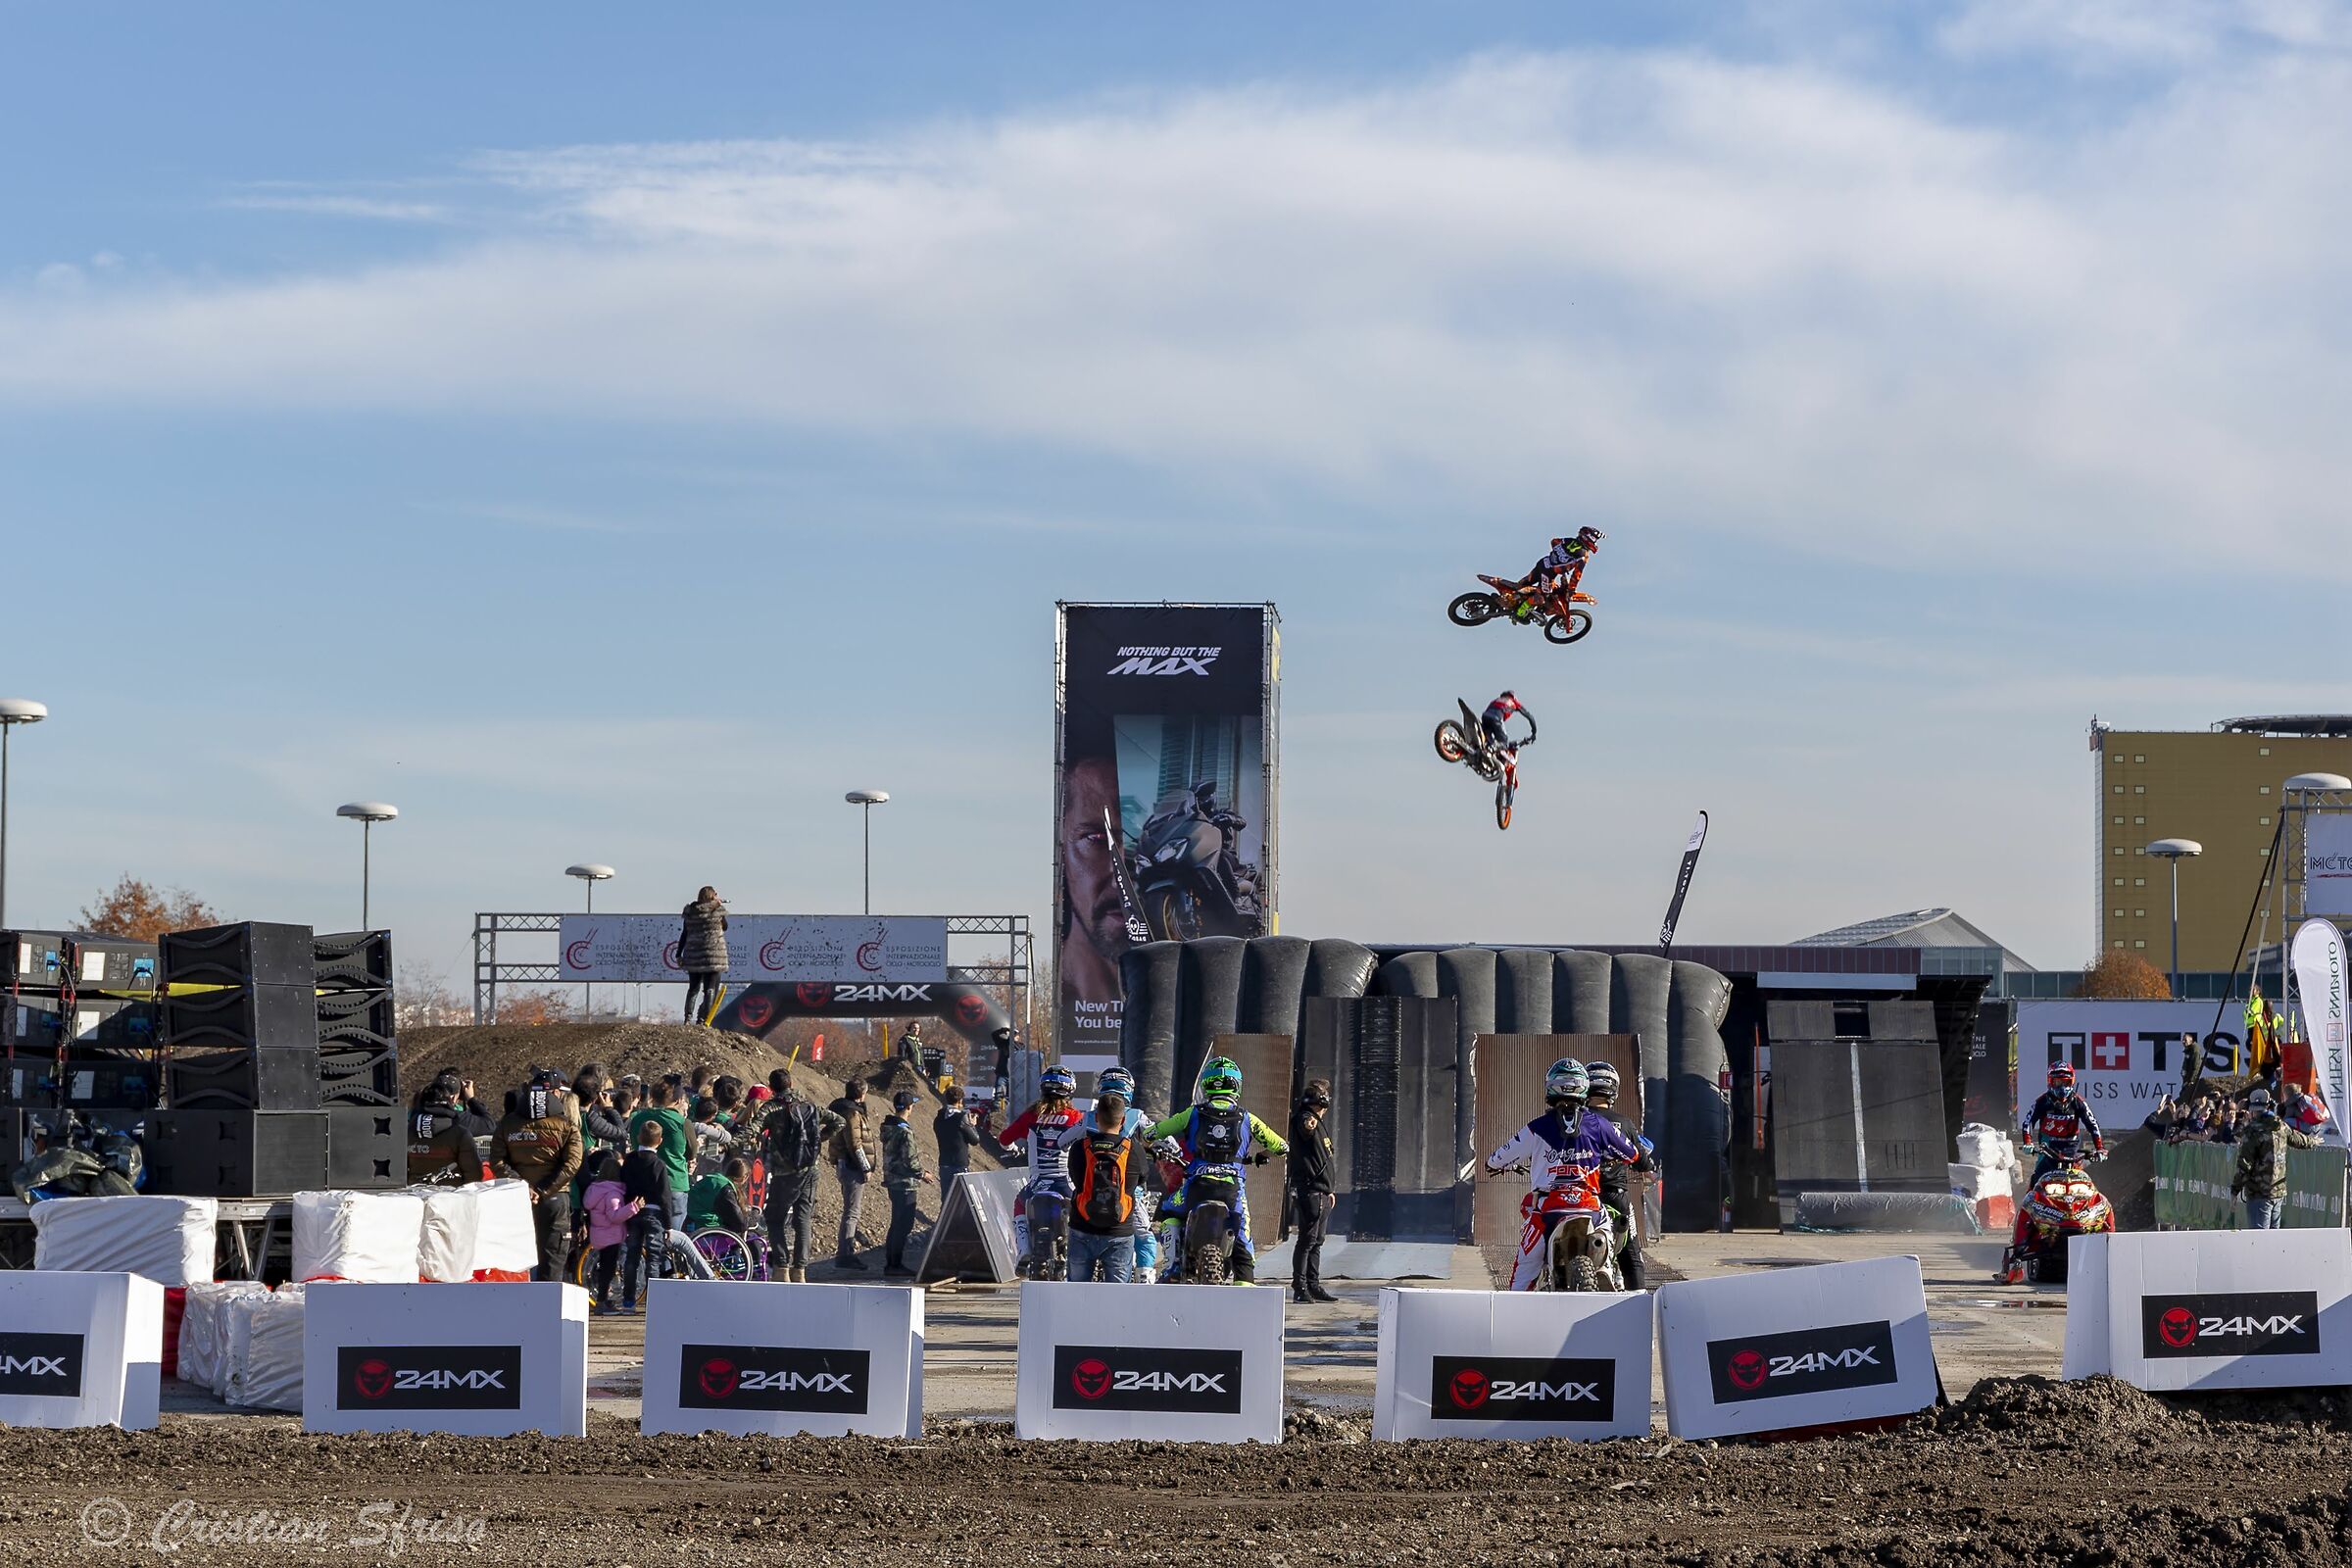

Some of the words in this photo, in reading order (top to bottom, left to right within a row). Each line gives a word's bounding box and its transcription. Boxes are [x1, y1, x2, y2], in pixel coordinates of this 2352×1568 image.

[1117, 646, 1170, 657] NOTHING
[1171, 646, 1196, 657] BUT
[1198, 646, 1222, 658] THE
[1106, 657, 1216, 675] MAX
[833, 984, 932, 1003] 24MX
[1074, 1000, 1108, 1012] New
[1074, 1015, 1102, 1029] You
[2032, 1201, 2065, 1218] POLARIS
[2198, 1314, 2305, 1337] 24MX
[0, 1355, 68, 1377] MX
[1769, 1346, 1882, 1377] 24MX
[394, 1370, 507, 1390] 24MX
[739, 1370, 854, 1394] 24MX
[1112, 1371, 1227, 1394] 24MX
[1490, 1381, 1600, 1401] 24MX
